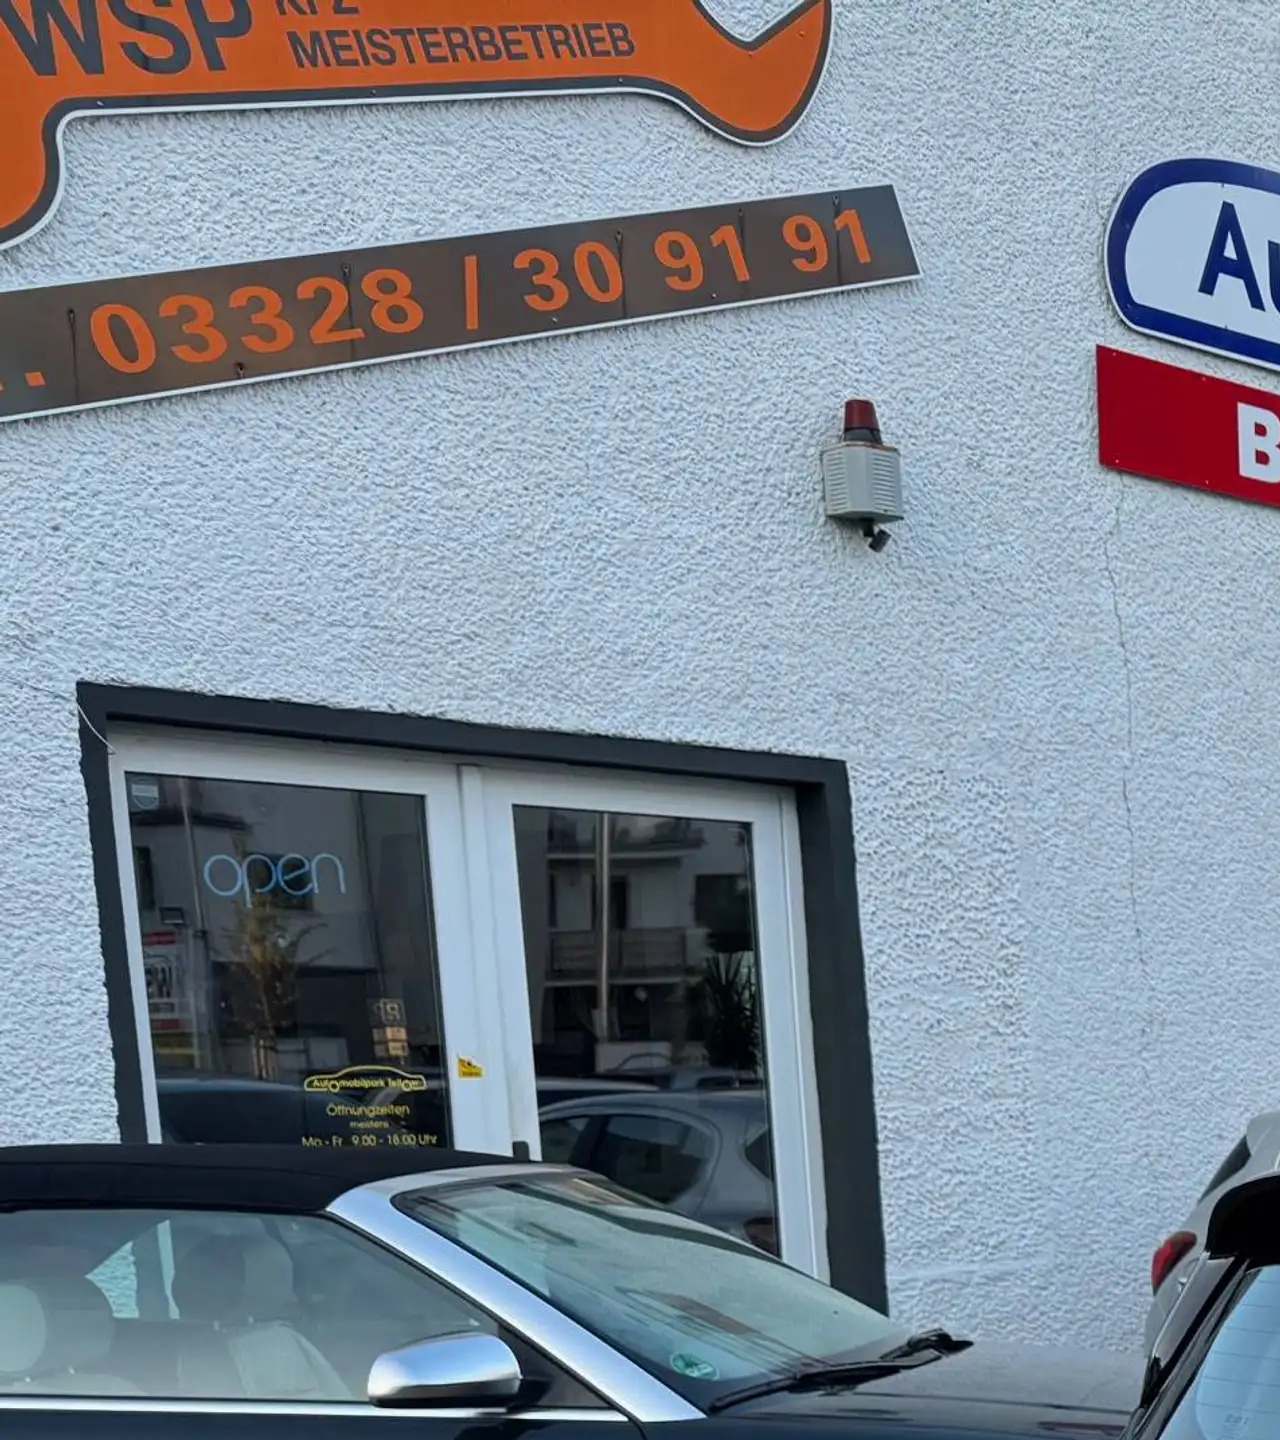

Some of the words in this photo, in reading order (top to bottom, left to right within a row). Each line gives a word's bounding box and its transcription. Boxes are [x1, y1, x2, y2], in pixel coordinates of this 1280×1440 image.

[0, 0, 252, 77] WSP
[286, 23, 636, 70] MEISTERBETRIEB
[90, 268, 425, 374] 03328
[465, 254, 479, 330] /
[513, 241, 624, 313] 30
[652, 224, 751, 292] 91
[781, 208, 873, 272] 91
[203, 853, 346, 909] open
[302, 1136, 323, 1147] Mo
[332, 1135, 343, 1147] Fr
[418, 1134, 438, 1145] Uhr
